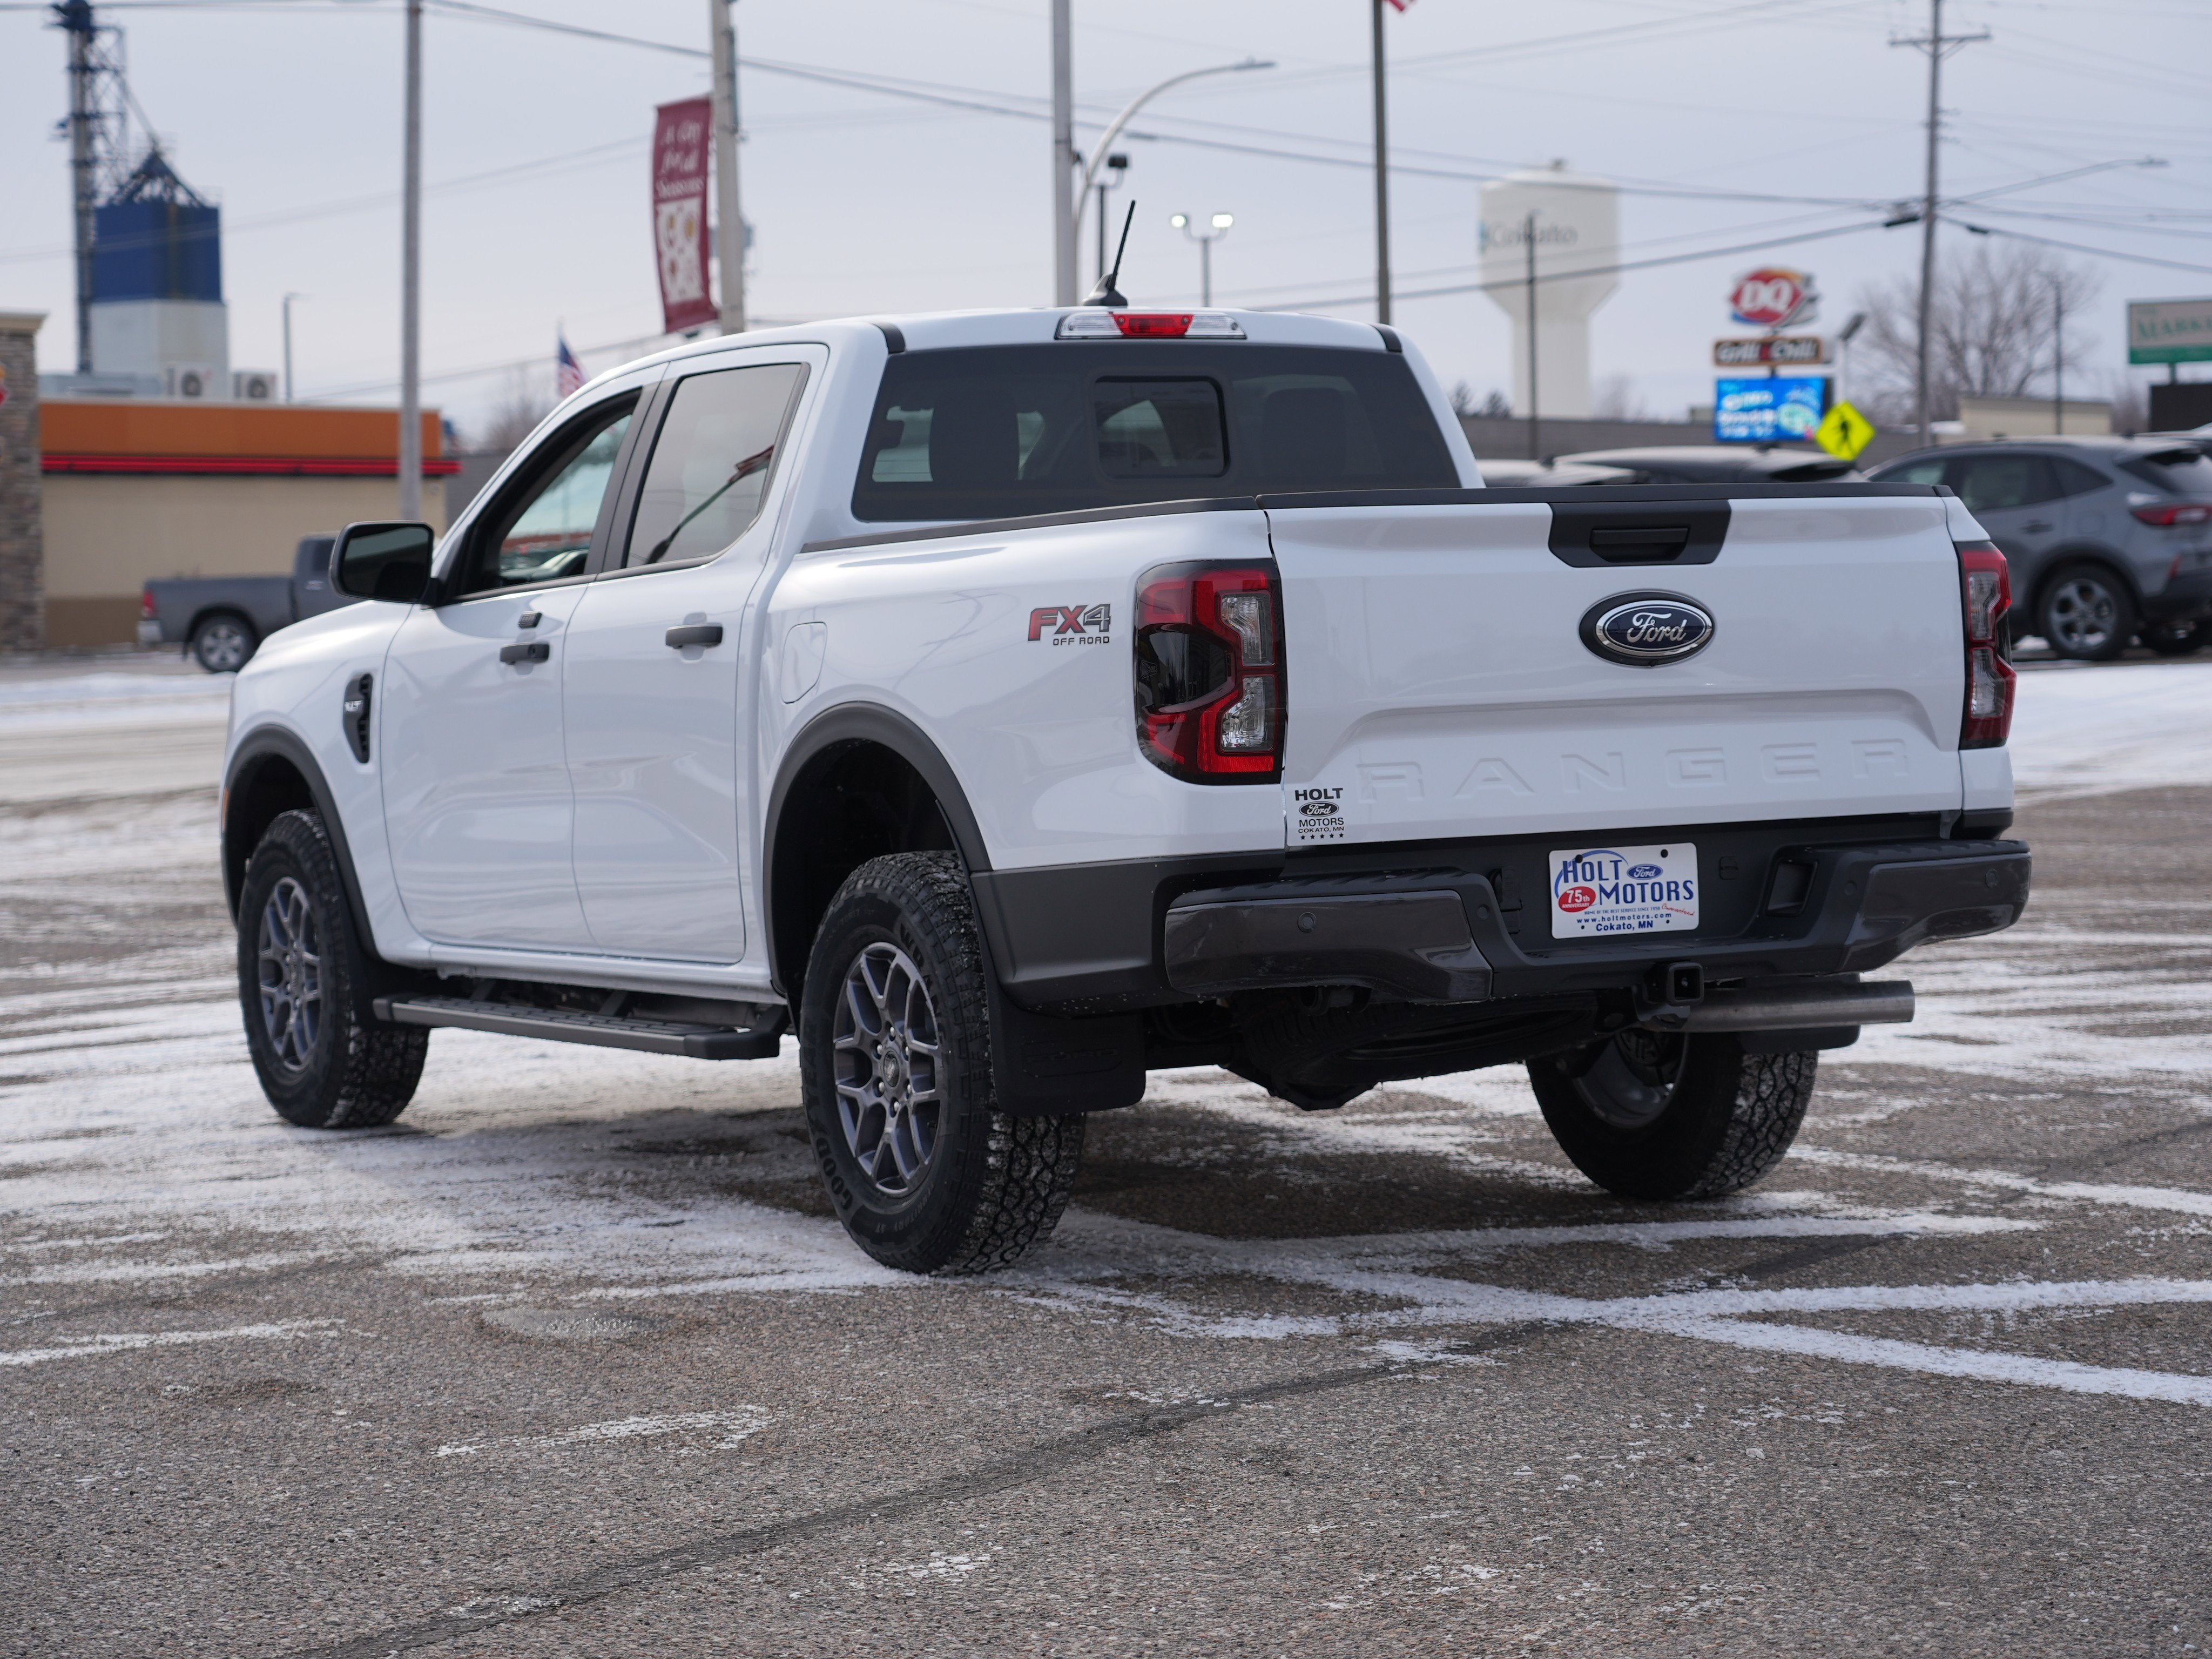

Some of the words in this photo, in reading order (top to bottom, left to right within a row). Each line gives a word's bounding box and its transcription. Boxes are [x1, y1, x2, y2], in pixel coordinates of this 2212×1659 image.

[1739, 278, 1795, 312] DQ
[1028, 604, 1111, 642] FX4
[1626, 612, 1688, 643] Ford
[1079, 636, 1109, 645] ROAD
[1355, 737, 1909, 804] RANGER
[1294, 787, 1344, 801] HOLT
[1306, 804, 1332, 815] Ford
[1299, 817, 1344, 827] MOTORS
[1562, 860, 1622, 883] HOLT
[1634, 866, 1656, 878] Ford
[1566, 889, 1590, 903] 75th
[1599, 880, 1694, 906] MOTORS
[1576, 913, 1671, 923] www.holtmotors.com
[1596, 921, 1635, 932] Cokato,
[1638, 920, 1654, 929] MN
